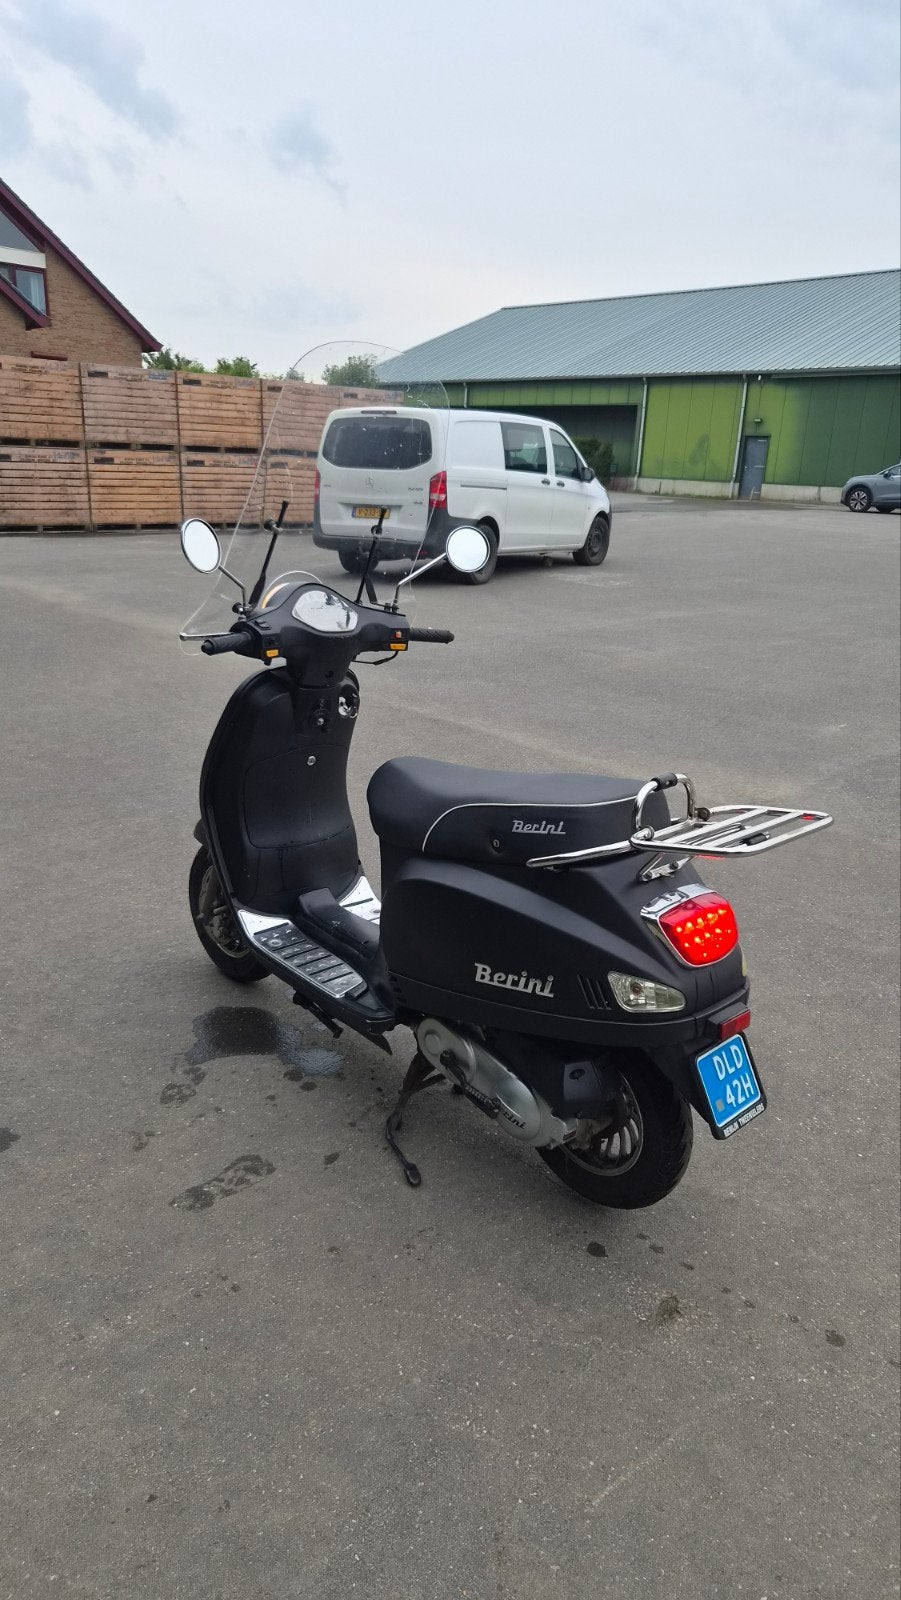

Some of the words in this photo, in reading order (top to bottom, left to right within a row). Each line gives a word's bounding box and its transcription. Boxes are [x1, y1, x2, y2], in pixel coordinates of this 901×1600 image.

[512, 820, 566, 834] Berini
[474, 962, 554, 998] Berini
[712, 1044, 744, 1081] DLD
[725, 1072, 755, 1108] 42H
